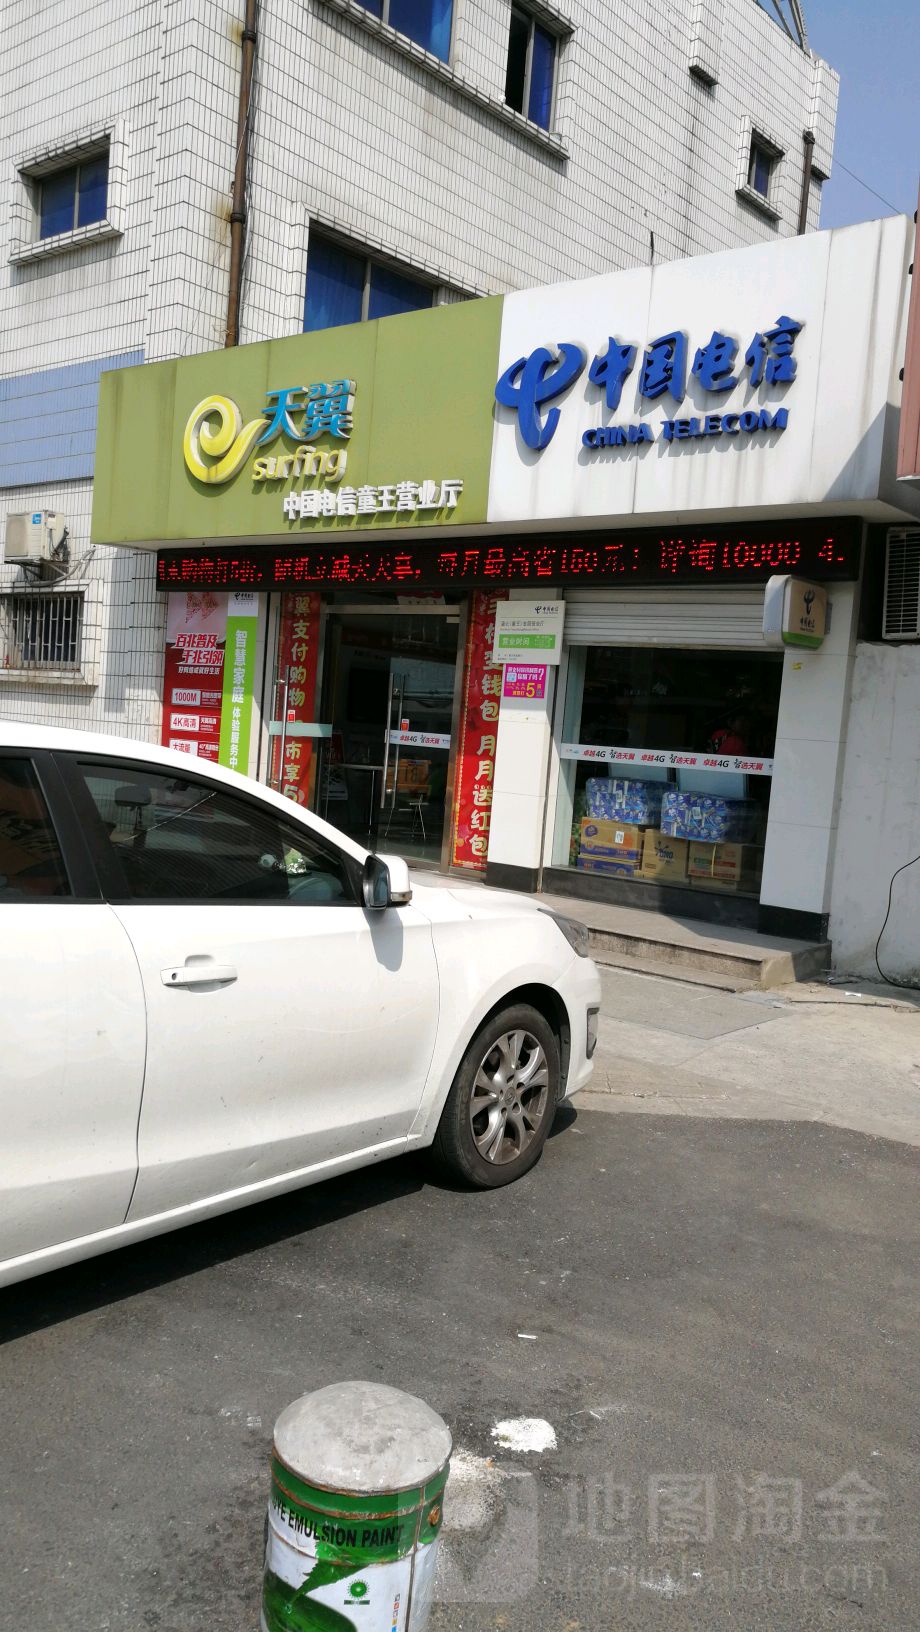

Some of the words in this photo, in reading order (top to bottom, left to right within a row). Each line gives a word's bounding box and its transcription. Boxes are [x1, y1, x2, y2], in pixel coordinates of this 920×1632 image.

[588, 315, 806, 410] 中国电信
[257, 379, 357, 443] 天翼
[581, 421, 653, 450] CHINA
[661, 407, 789, 442] TELECOM
[252, 445, 348, 482] surfing
[283, 478, 464, 520] 中国电信童王营业厅
[176, 633, 218, 648] 百兆普及
[182, 650, 223, 665] 千兆引领
[175, 692, 197, 702] 1000M
[173, 717, 197, 728] 4K高清
[288, 1508, 358, 1548] EMULSION
[361, 1523, 405, 1548] PAINT
